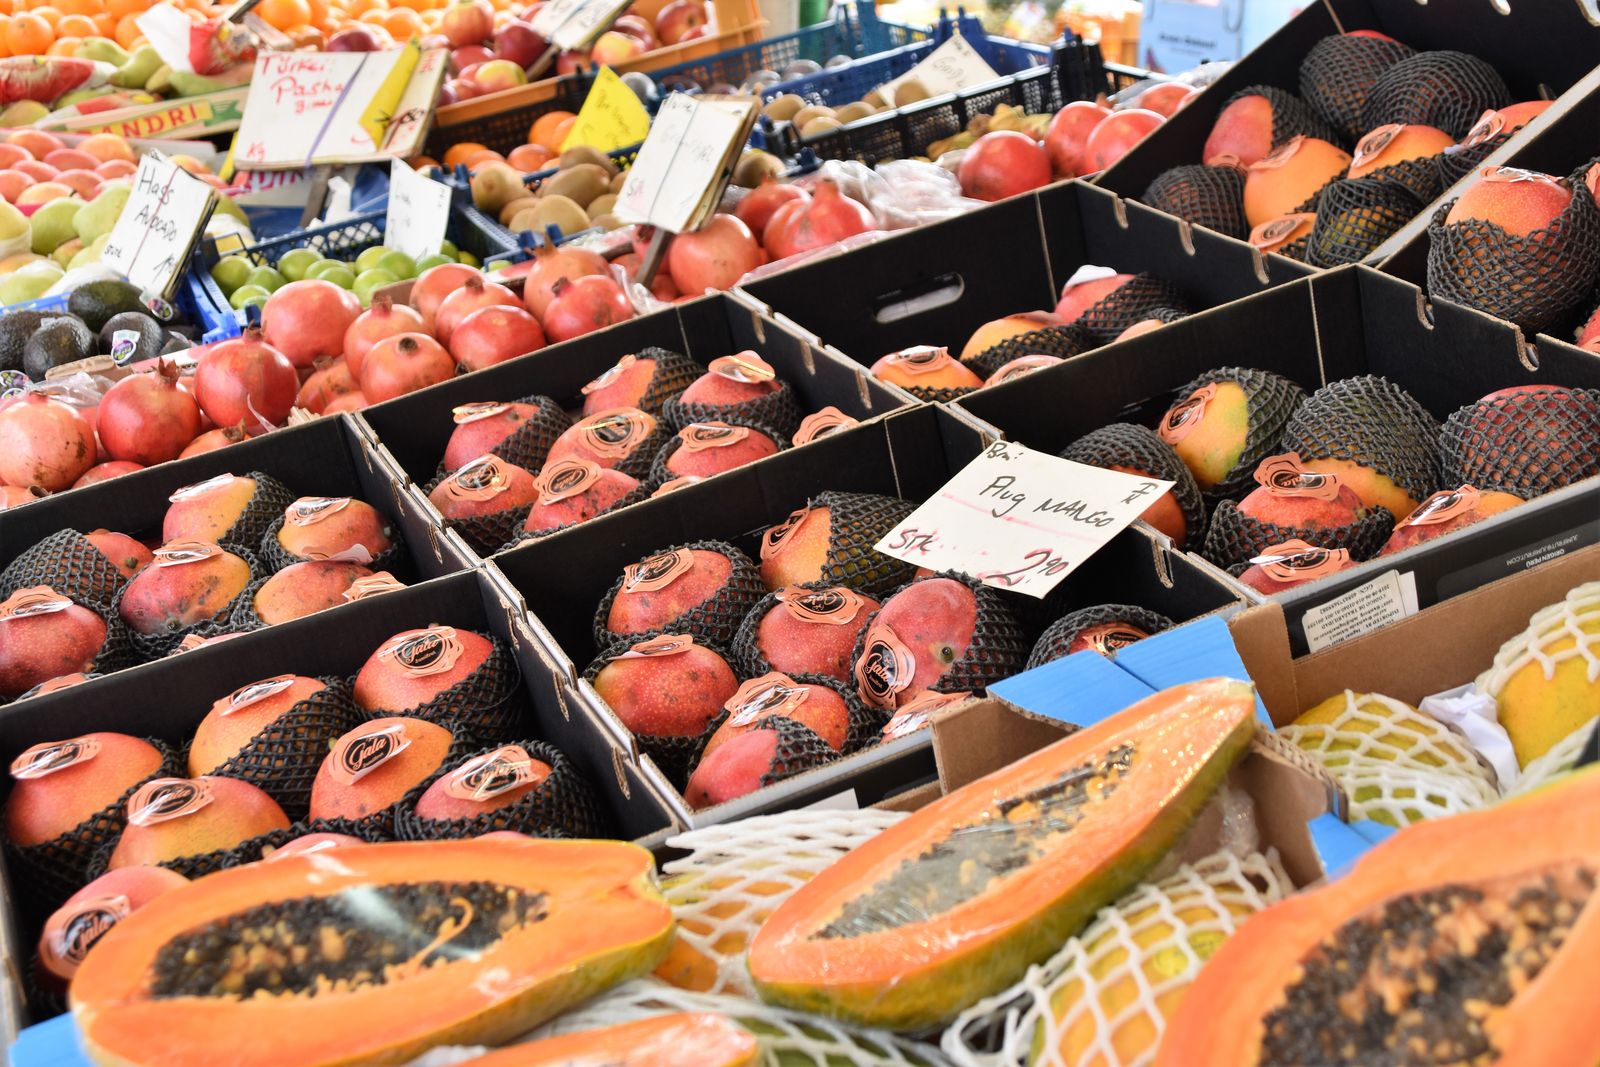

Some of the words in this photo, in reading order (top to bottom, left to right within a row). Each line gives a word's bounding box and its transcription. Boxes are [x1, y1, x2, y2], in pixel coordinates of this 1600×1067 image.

[1032, 498, 1114, 528] MANGO
[1543, 549, 1565, 562] ORIGEN
[401, 637, 439, 664] Gala
[349, 738, 387, 771] Gala
